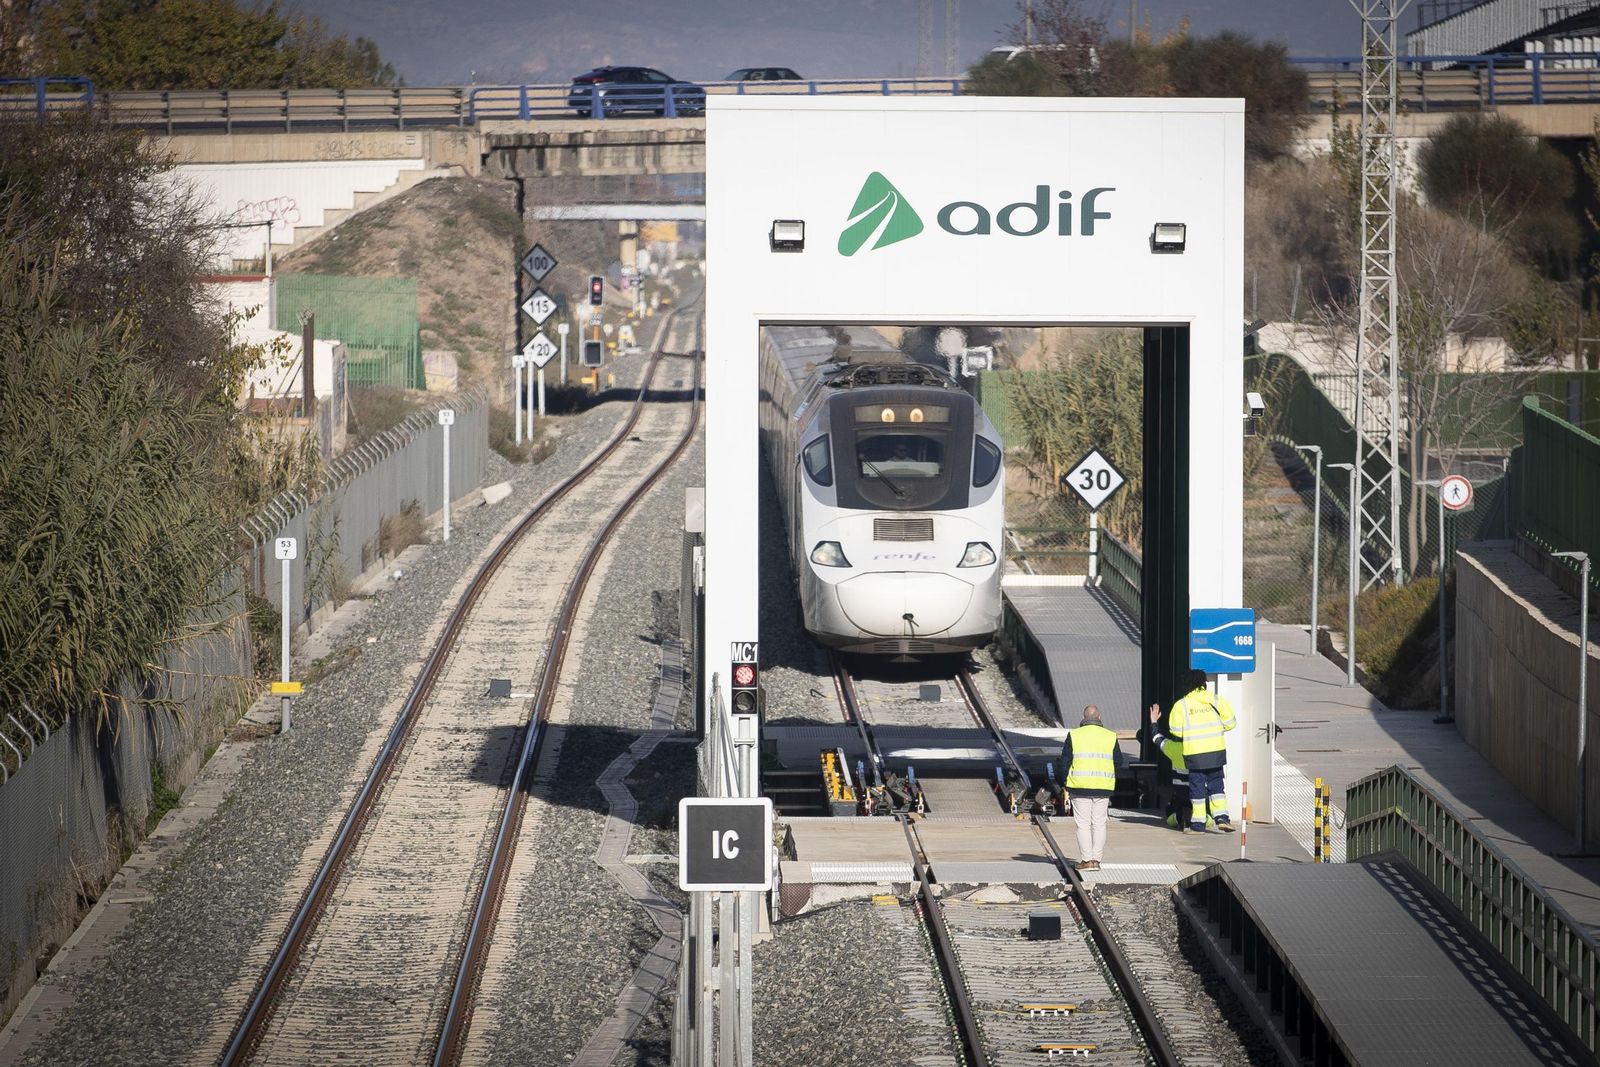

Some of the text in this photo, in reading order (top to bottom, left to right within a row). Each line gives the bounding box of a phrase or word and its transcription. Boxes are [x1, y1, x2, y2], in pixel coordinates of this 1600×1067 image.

[937, 185, 1116, 236] adif
[528, 257, 548, 270] 100
[529, 301, 549, 313] 115
[1079, 468, 1111, 490] 30
[872, 552, 937, 561] renfe
[1234, 636, 1253, 646] 1668
[731, 642, 758, 662] MC1
[712, 829, 740, 860] IC
